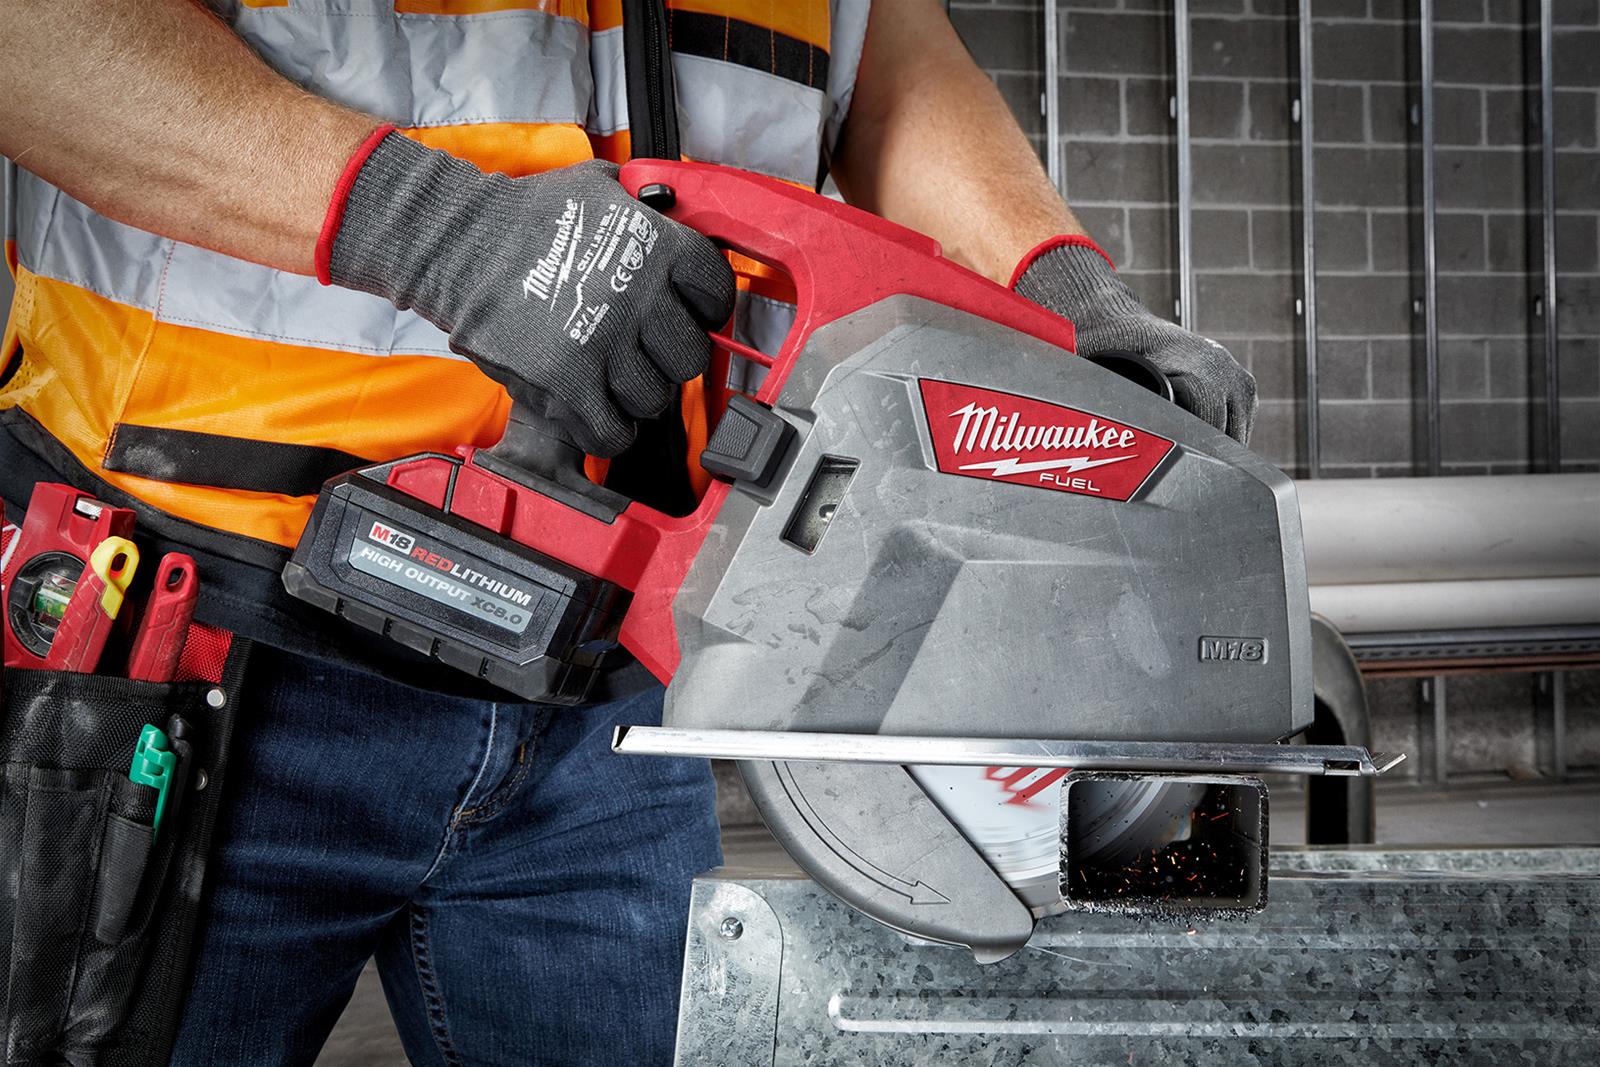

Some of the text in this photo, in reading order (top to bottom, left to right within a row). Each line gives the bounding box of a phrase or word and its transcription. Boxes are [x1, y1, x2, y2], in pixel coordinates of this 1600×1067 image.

[523, 199, 578, 300] Milwaukee
[948, 401, 1137, 455] Milwaukee
[1039, 473, 1101, 492] FUEL
[371, 524, 412, 550] M18
[360, 547, 523, 626] HIGH OUTPUT XC8.0
[1201, 639, 1264, 661] M18
